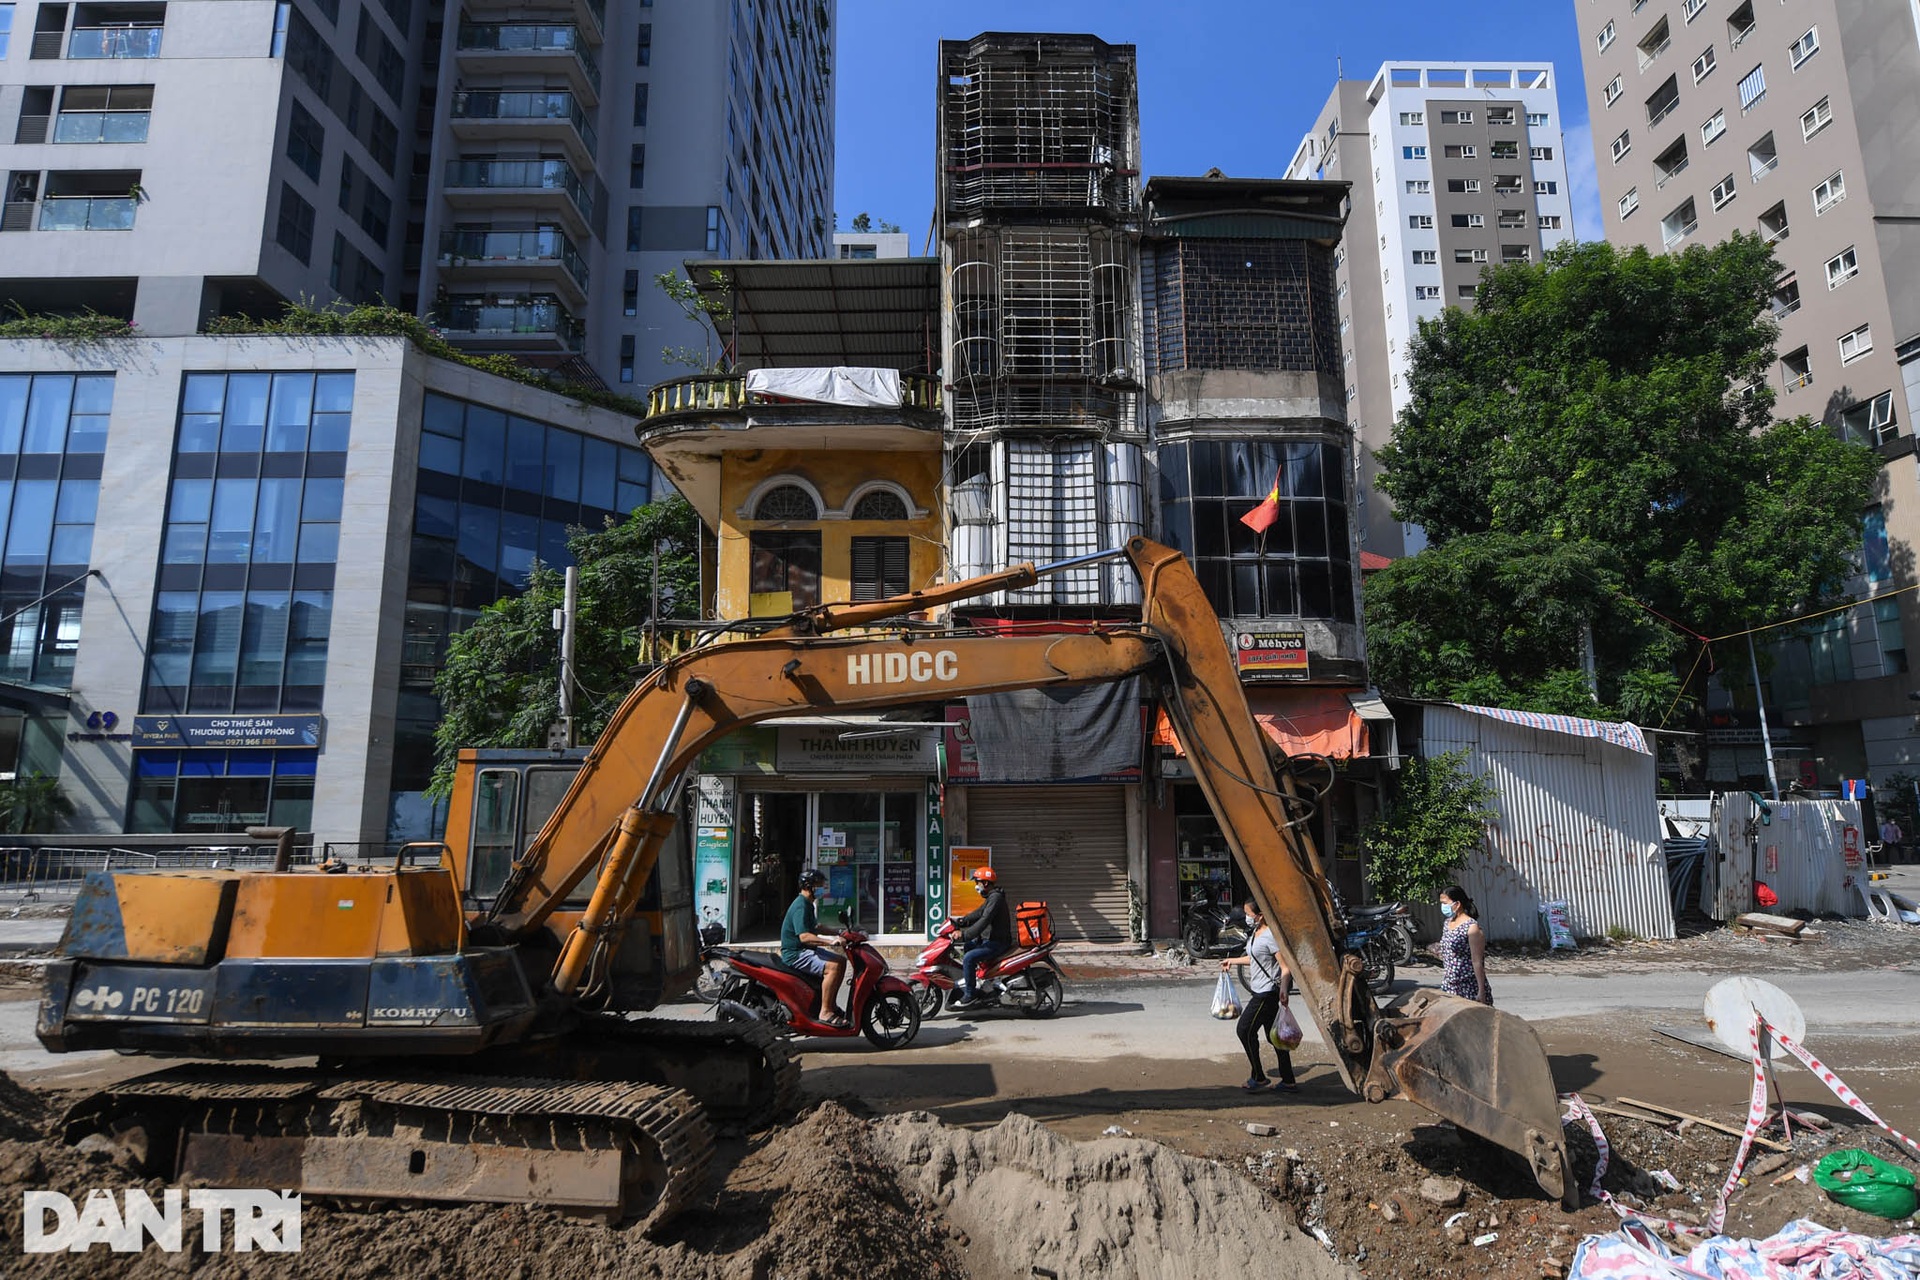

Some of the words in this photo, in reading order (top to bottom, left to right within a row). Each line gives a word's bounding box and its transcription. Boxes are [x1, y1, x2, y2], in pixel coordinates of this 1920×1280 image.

[1258, 638, 1302, 649] Mêhycô
[847, 650, 958, 684] HIDCC
[86, 711, 118, 730] 69
[231, 718, 253, 727] THUÊ
[229, 728, 244, 738] MẠI
[264, 727, 295, 736] PHÒNG
[225, 738, 244, 746] 0971
[800, 739, 859, 751] THANH
[701, 799, 732, 808] THANH
[929, 782, 941, 834] NHÀ
[130, 987, 161, 1012] PC
[166, 988, 204, 1013] 120
[372, 1008, 467, 1018] KOMATU
